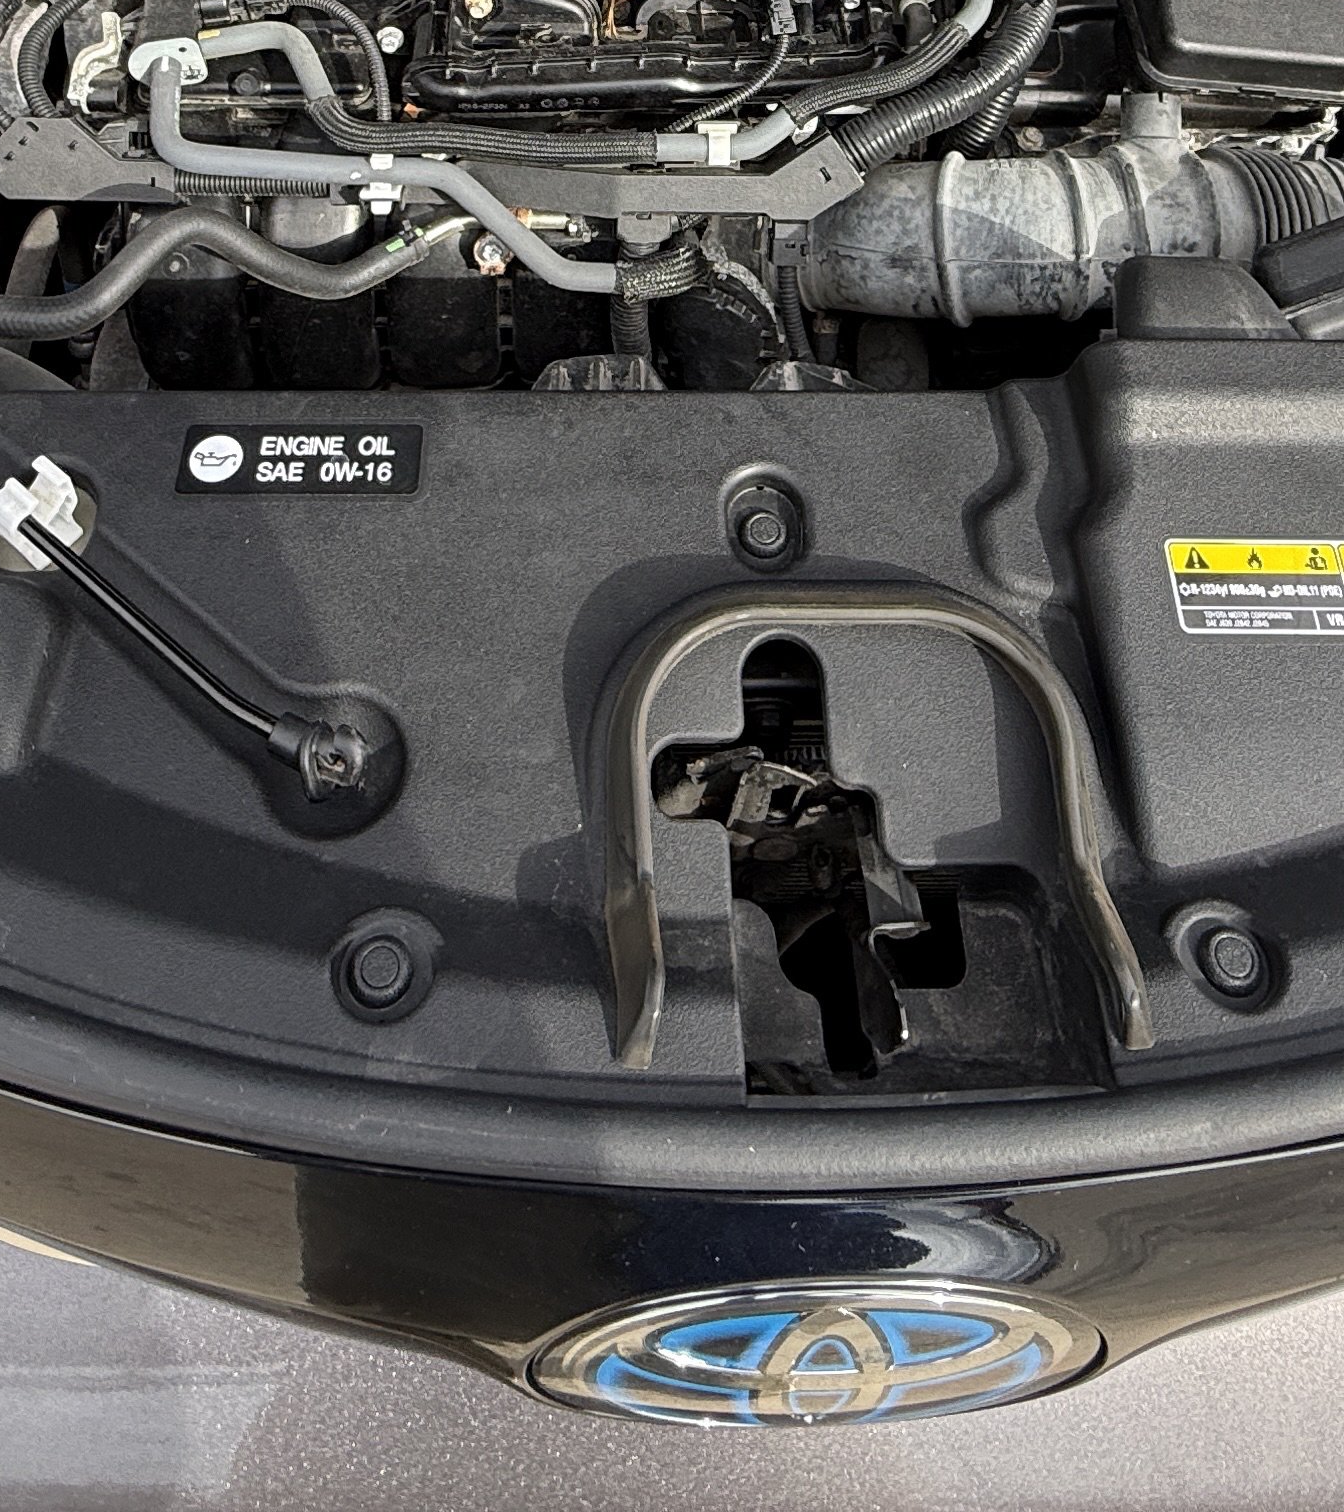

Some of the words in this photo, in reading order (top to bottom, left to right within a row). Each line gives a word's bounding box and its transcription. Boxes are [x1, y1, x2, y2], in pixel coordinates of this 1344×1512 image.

[259, 436, 345, 456] ENGINE
[357, 436, 396, 456] OIL
[255, 461, 304, 482] SAE
[319, 461, 393, 483] 0W-16
